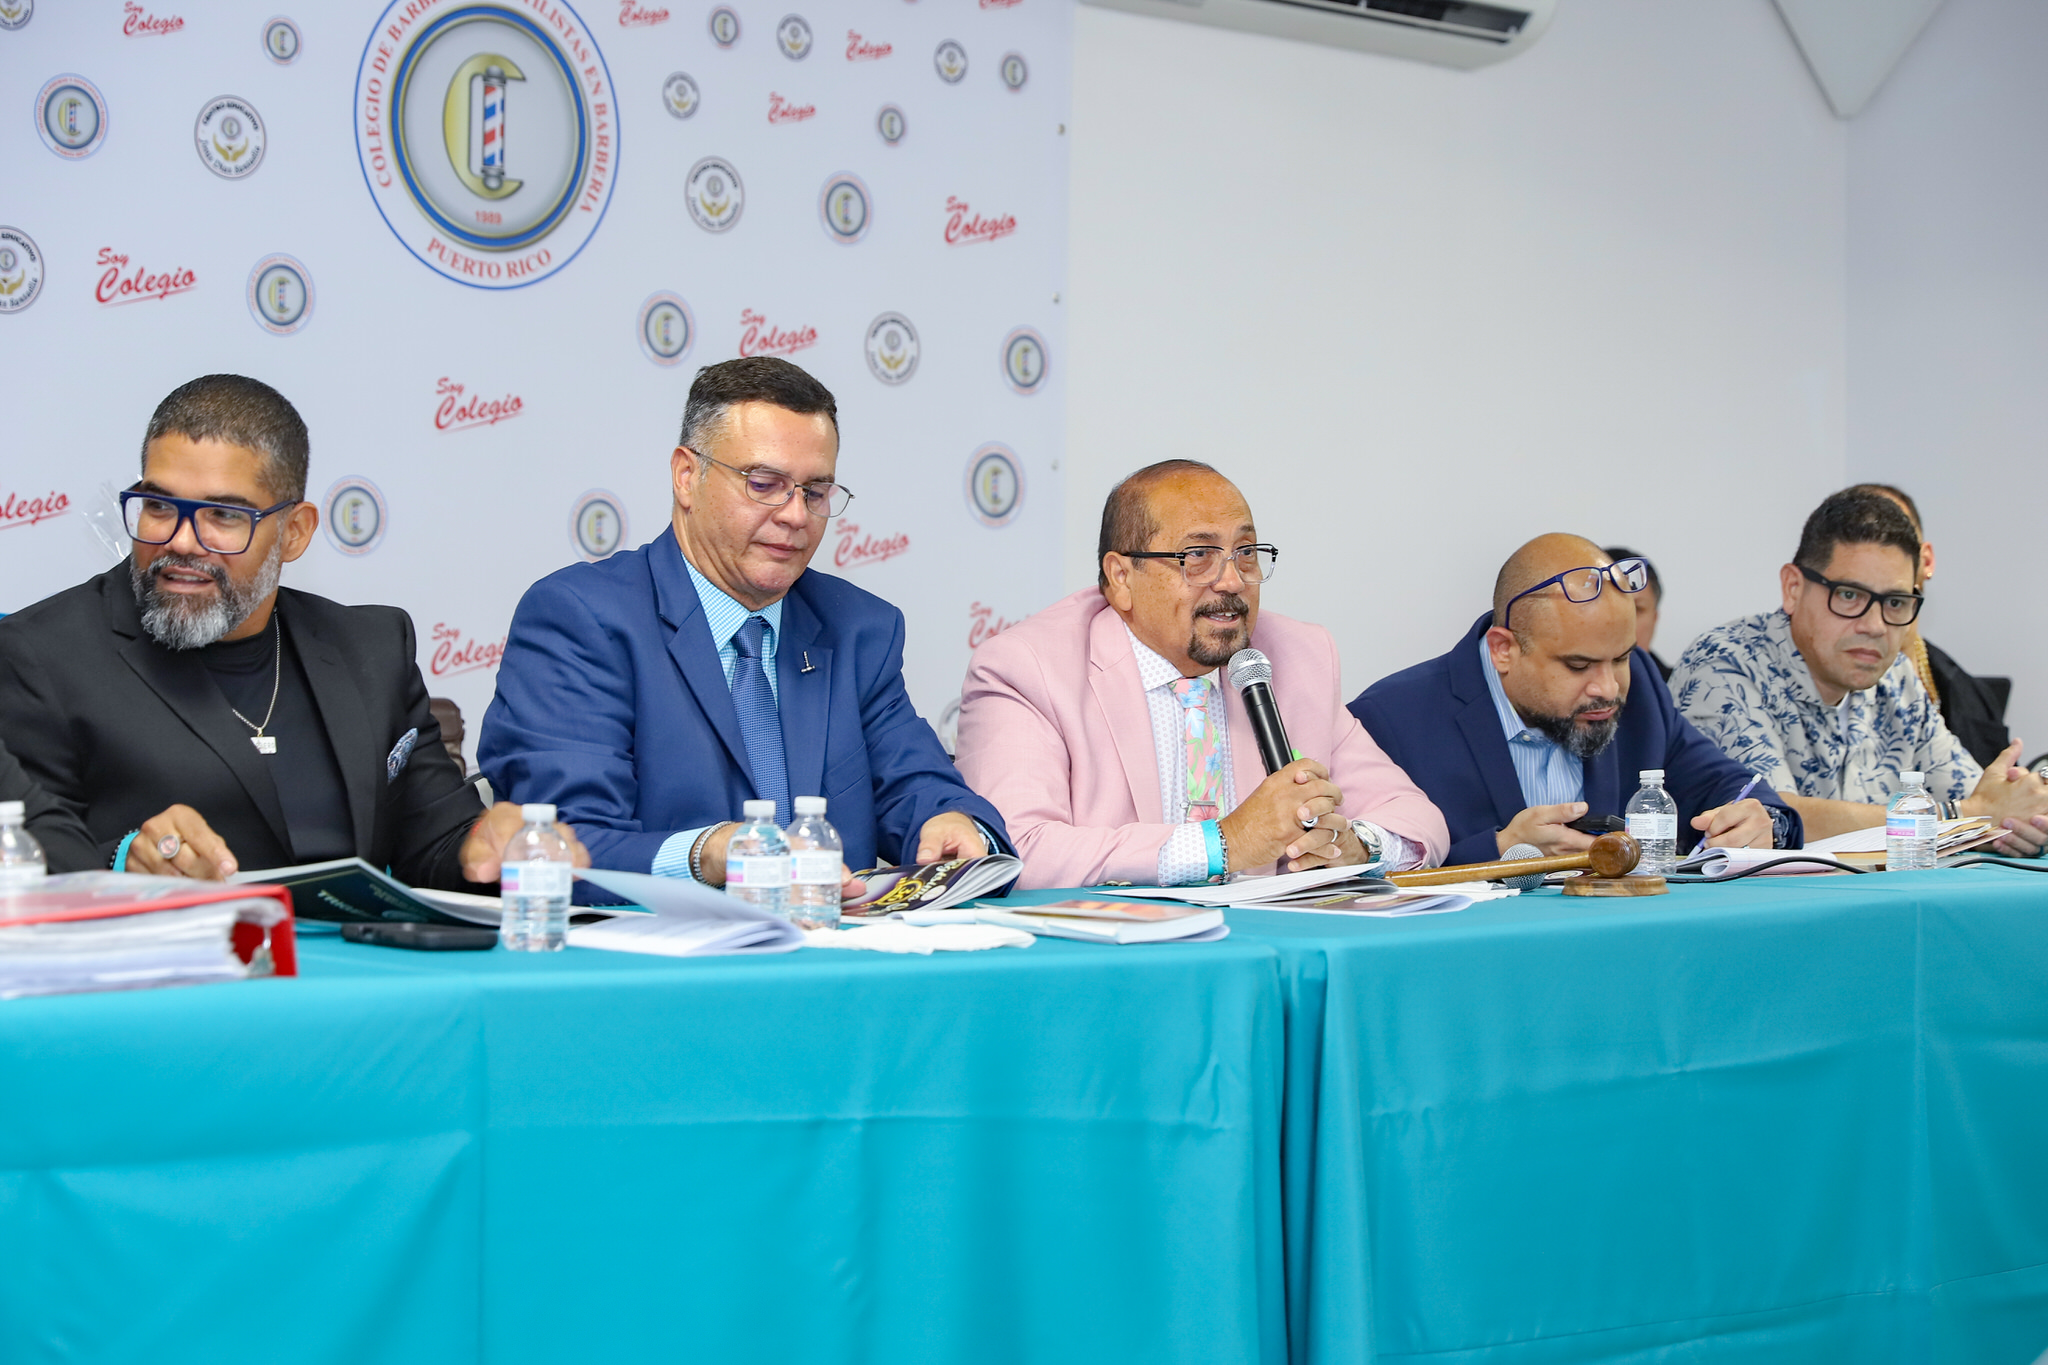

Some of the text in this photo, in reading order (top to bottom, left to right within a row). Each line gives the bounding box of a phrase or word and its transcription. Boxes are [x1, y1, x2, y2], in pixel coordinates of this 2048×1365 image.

[123, 13, 184, 36] Colegio
[365, 0, 610, 213] COLEGIO DE BARB ILISTAS EN BARBERIA
[945, 196, 969, 213] Soy
[944, 212, 1016, 243] Colegio
[97, 247, 129, 268] Soy
[427, 237, 552, 280] PUERTO RICO
[95, 264, 196, 303] Colegio
[740, 308, 766, 327] Soy
[739, 326, 818, 357] Colegio
[436, 377, 464, 397] Soy
[434, 394, 523, 431] Colegio
[0, 491, 69, 526] legio
[834, 532, 910, 568] Colegio
[432, 622, 460, 642] Soy
[431, 637, 506, 675] Colegi
